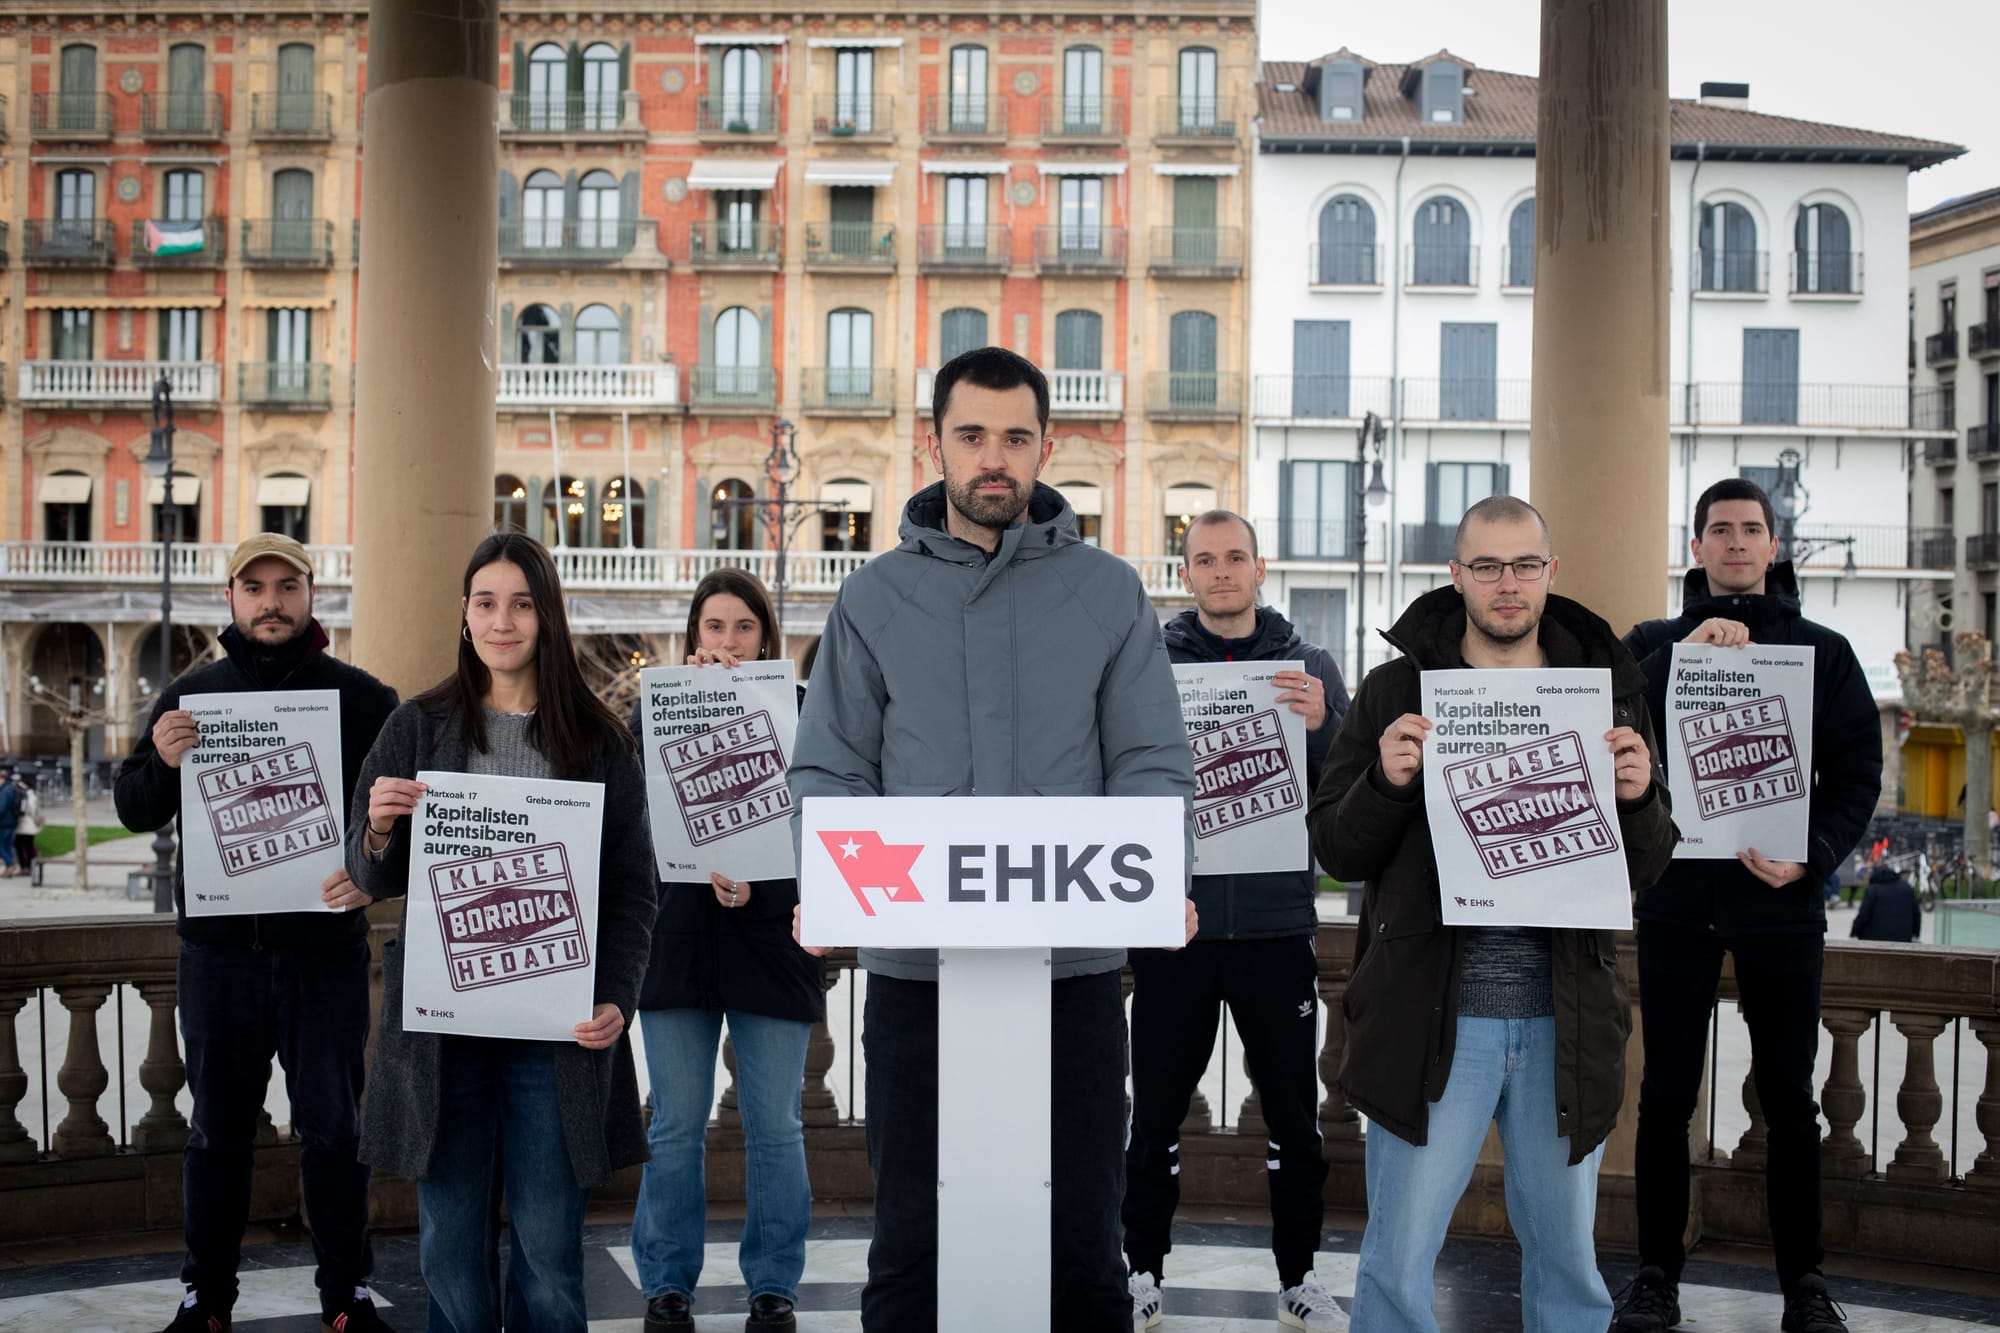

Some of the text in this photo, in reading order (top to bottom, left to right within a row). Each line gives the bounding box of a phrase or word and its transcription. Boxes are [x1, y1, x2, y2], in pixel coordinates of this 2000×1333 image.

[1751, 658, 1804, 667] Greba orokorra
[1677, 668, 1755, 683] Kapitalisten
[651, 681, 682, 689] Martxoak
[1435, 687, 1487, 696] Martxoak 17
[1536, 685, 1600, 694] Greba orokorra
[1675, 683, 1761, 697] ofentsibaren
[651, 690, 737, 707] Kapitalisten
[1181, 688, 1247, 703] pitalisten
[652, 704, 745, 722] ofentsibaren
[1181, 703, 1254, 716] entsibaren
[1435, 701, 1541, 720] Kapitalisten
[1675, 700, 1726, 711] aurrean
[653, 723, 710, 737] aurrean
[1184, 720, 1220, 731] rean
[1436, 719, 1550, 736] ofentsibaren
[1694, 705, 1771, 738] KLASE
[678, 721, 757, 764] KLASE
[1436, 740, 1507, 755] aurrean
[191, 752, 250, 764] aurrean
[1695, 737, 1790, 777] BORROKA
[215, 753, 298, 792] KLASE
[1464, 744, 1564, 790] KLASE
[681, 752, 780, 802] BORROKA
[426, 789, 477, 800] Martxoak 17
[526, 796, 591, 808] Greba orokorra
[1703, 775, 1797, 813] HEDATU
[217, 785, 320, 832] BORROKA
[425, 803, 529, 826] Kapitalisten
[693, 789, 790, 838] HEDATU
[1199, 786, 1294, 831] HEDATU
[1469, 784, 1588, 832] BORROKA
[424, 821, 537, 844] ofentsibaren
[228, 823, 331, 868] HEDATU
[423, 840, 493, 857] aurrean
[1488, 828, 1607, 870] HEDATU
[449, 853, 548, 891] KLASE
[948, 843, 1155, 903] EHKS
[1470, 899, 1495, 907] EHKS
[450, 893, 570, 938] BORROKA
[458, 939, 579, 982] HEDATU
[431, 1010, 455, 1019] EHKS
